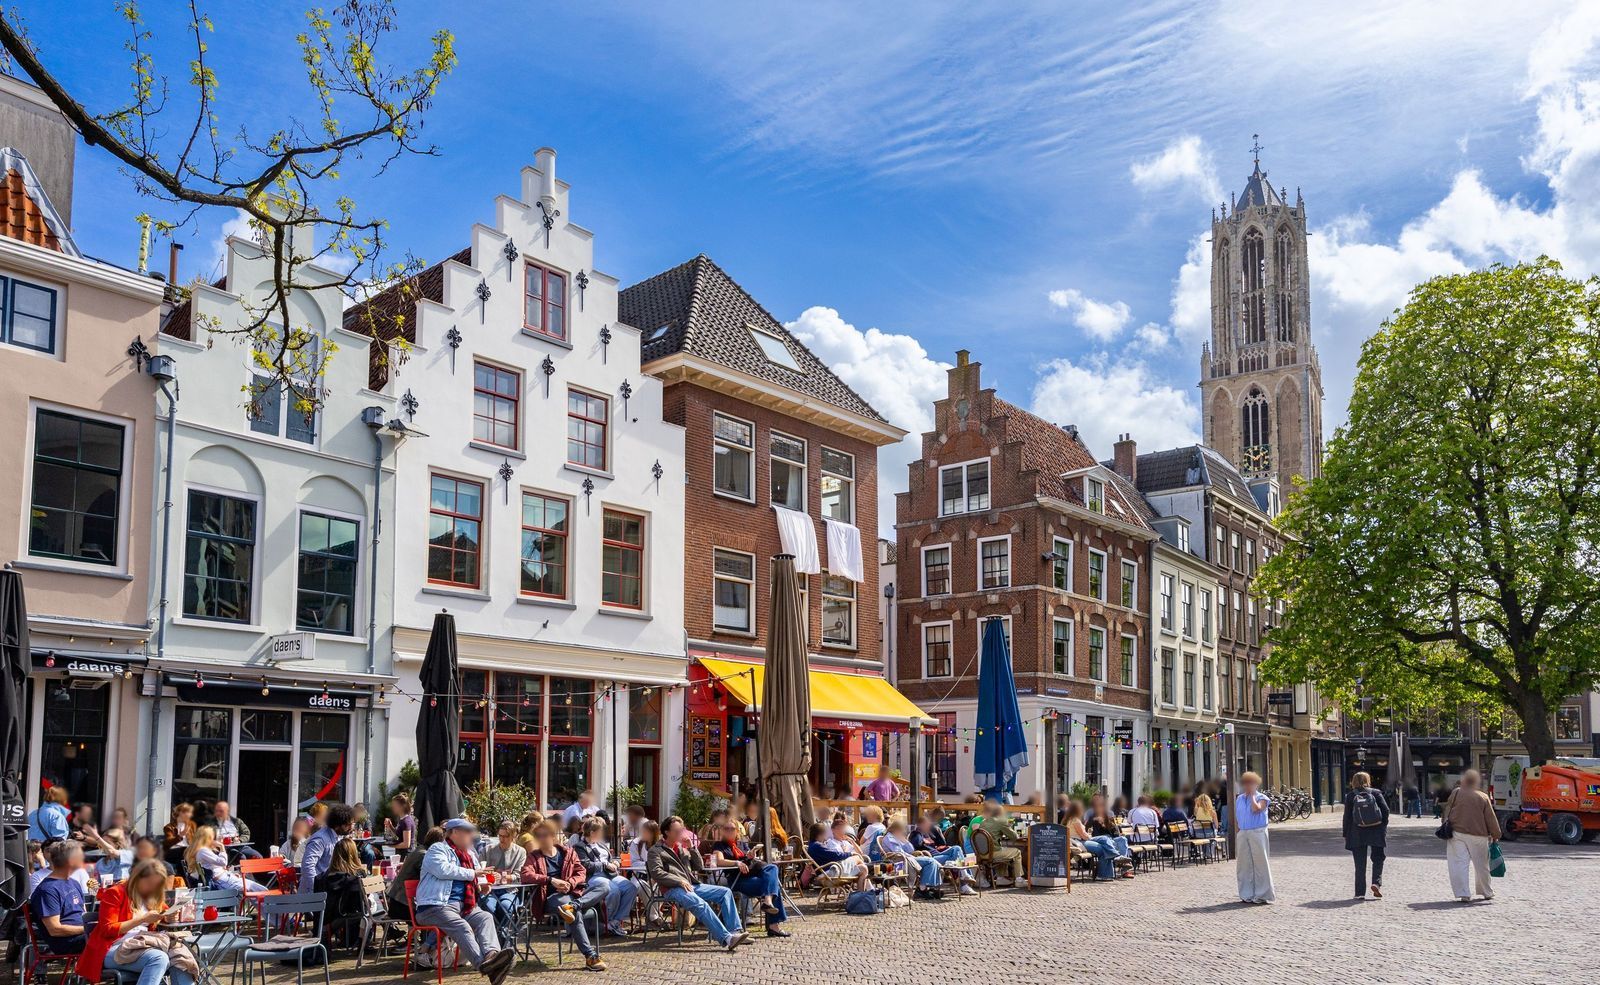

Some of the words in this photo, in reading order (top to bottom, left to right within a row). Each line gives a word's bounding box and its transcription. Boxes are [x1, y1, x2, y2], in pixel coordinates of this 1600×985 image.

[273, 638, 301, 652] daen's
[67, 660, 124, 674] daen's
[309, 694, 351, 708] daen's
[2, 803, 25, 818] 's
